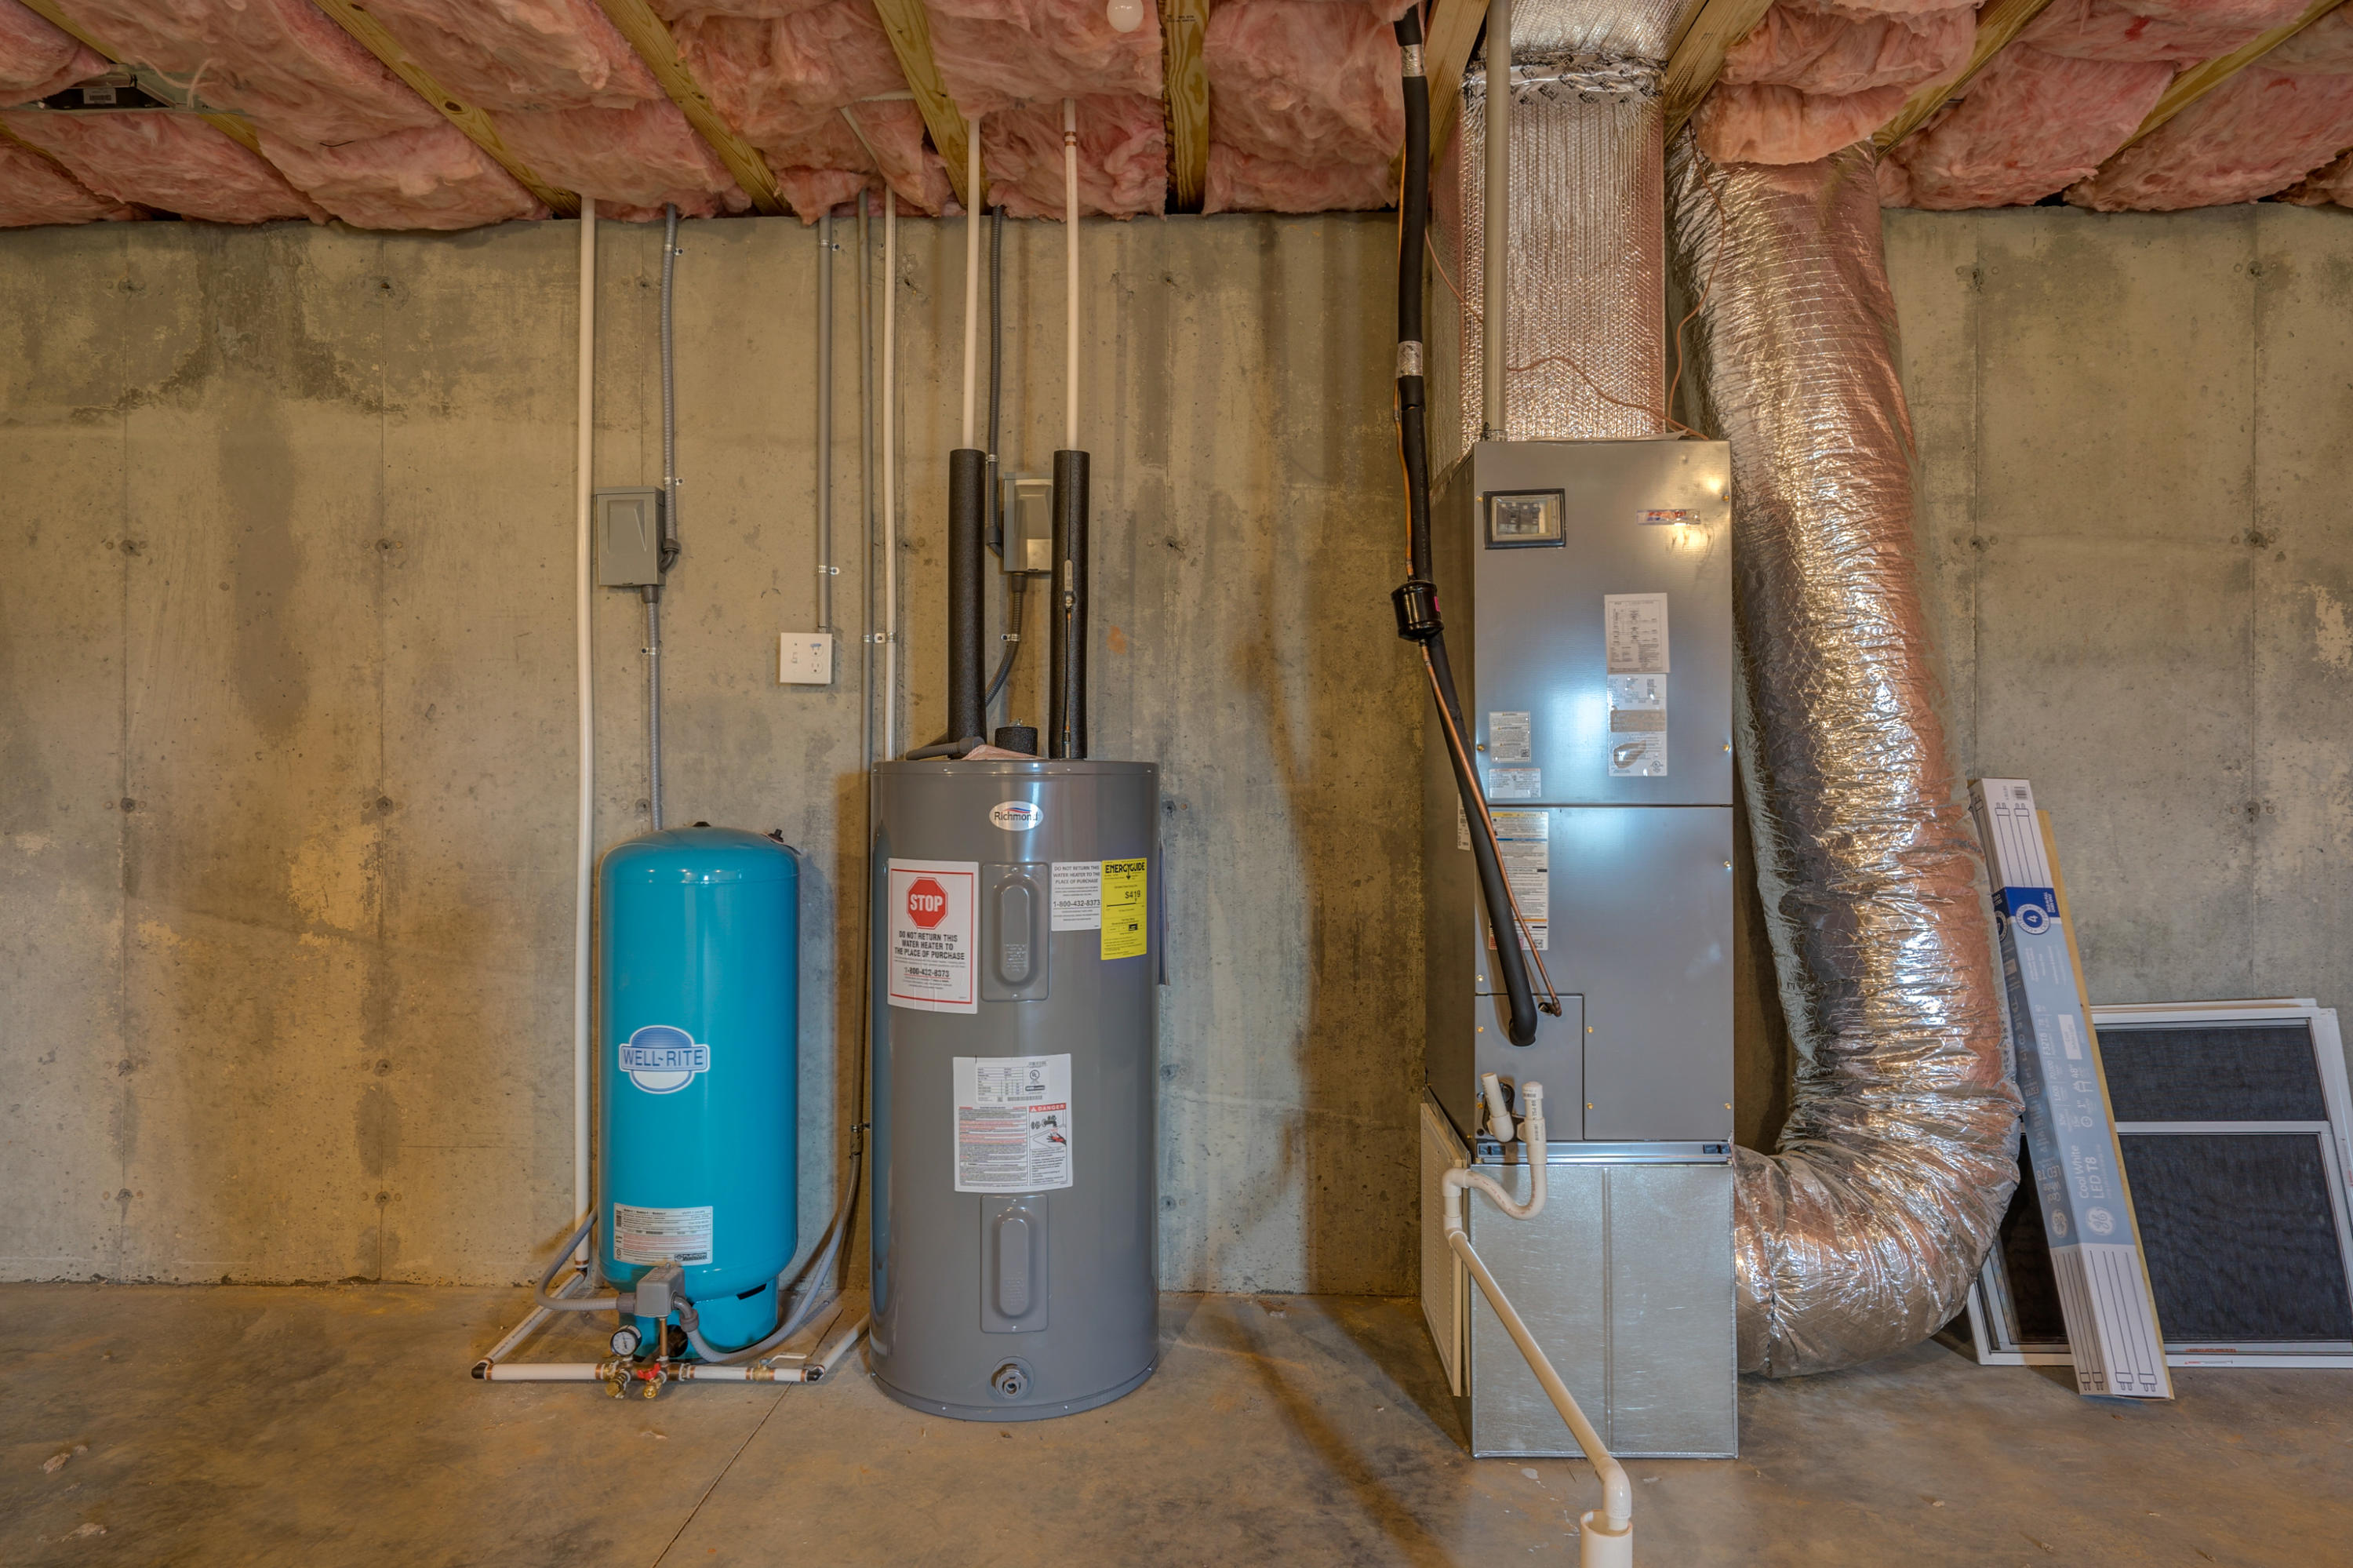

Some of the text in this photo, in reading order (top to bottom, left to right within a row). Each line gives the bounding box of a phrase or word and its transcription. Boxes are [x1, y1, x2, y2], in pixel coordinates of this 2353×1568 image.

[910, 894, 943, 911] STOP
[918, 933, 941, 941] RETURN
[921, 941, 943, 950] HEATER
[904, 948, 920, 957] PLACE
[2071, 1145, 2089, 1199] Cool White
[2085, 1156, 2104, 1199] LED T8
